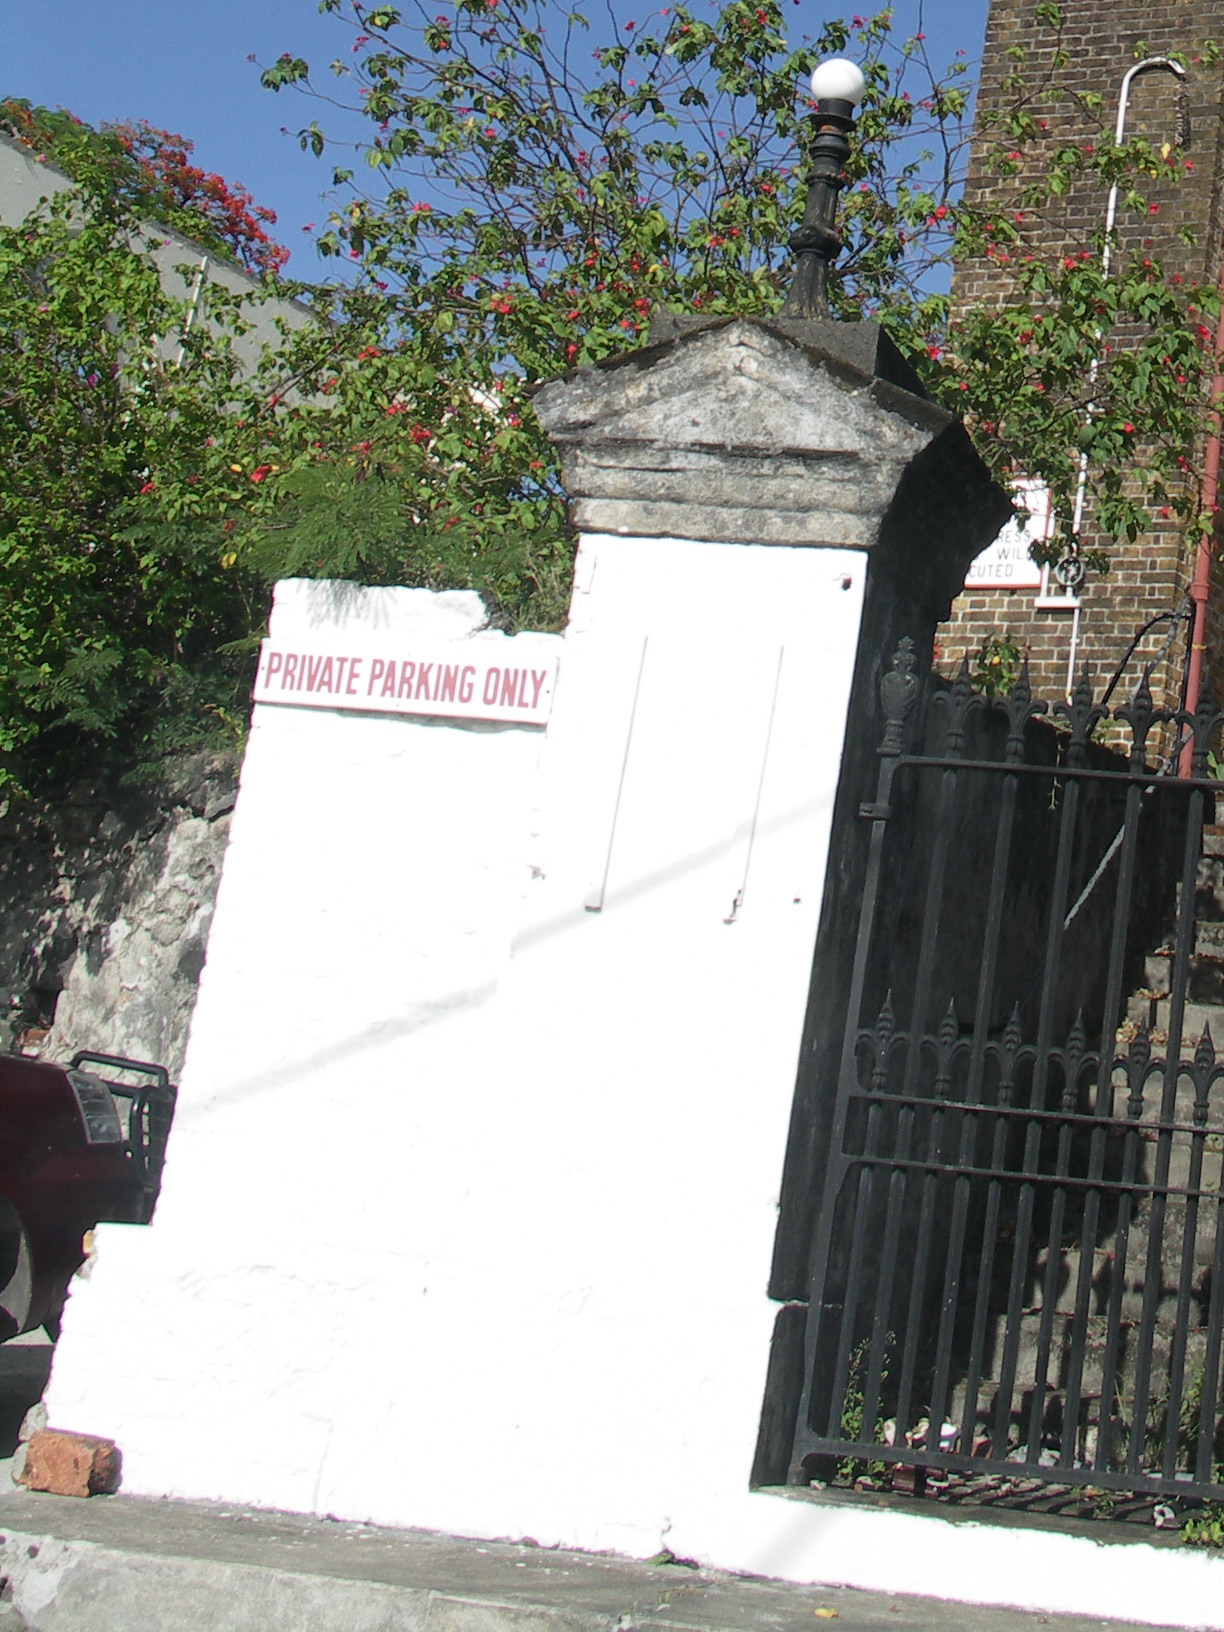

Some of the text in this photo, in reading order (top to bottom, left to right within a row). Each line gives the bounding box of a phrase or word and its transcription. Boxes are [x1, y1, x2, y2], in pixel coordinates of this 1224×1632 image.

[997, 546, 1030, 561] WIL
[264, 652, 548, 710] PRIVATE PARKING ONLY
